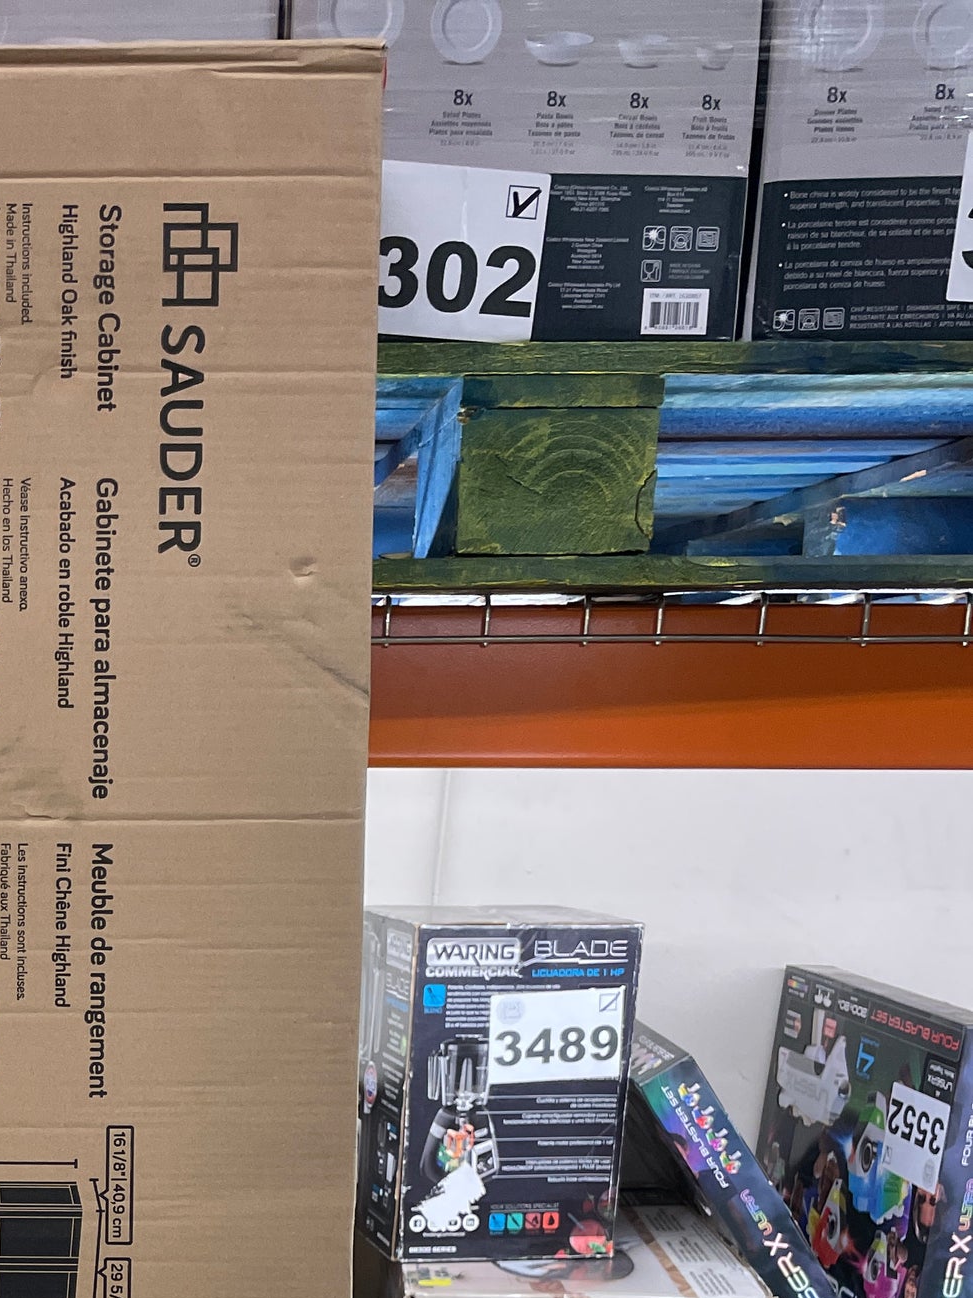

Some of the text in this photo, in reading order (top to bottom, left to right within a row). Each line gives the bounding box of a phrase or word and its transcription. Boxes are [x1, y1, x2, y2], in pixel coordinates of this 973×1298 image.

[453, 89, 474, 106] 8x
[546, 90, 567, 107] 8x
[629, 92, 650, 109] 8x
[701, 94, 721, 111] 8x
[827, 86, 848, 104] 8x
[935, 83, 956, 100] 8x
[5, 203, 18, 303] Made in Thailand
[20, 203, 33, 326] Instructions included.
[58, 204, 79, 379] Highland Oak finish
[93, 204, 123, 412] Storage Cabinet
[19, 477, 32, 513] Véase
[1, 478, 14, 603] Hecho en los Thailand
[19, 515, 31, 574] instructivo
[54, 476, 77, 709] Acabado en roble Highland
[87, 477, 120, 800] Gabinete para almacenaje
[17, 842, 29, 862] Les
[0, 891, 9, 912] aux
[17, 864, 28, 928] instructions
[0, 913, 12, 961] Thailand
[16, 929, 27, 954] sont
[51, 843, 73, 1008] Fini Chêne Highland
[84, 843, 114, 1099] Meuble de rangement
[433, 939, 629, 966] WARING BLADE
[586, 968, 600, 977] DE
[610, 968, 625, 977] HP
[494, 1025, 620, 1067] 3489
[870, 1008, 960, 1051] FOUR BLASTER SET
[888, 1098, 945, 1155] 3552
[110, 1131, 127, 1238] 16 1/8" 40,9 cm
[763, 1233, 789, 1256] X
[949, 1232, 973, 1254] X
[110, 1263, 124, 1283] 29
